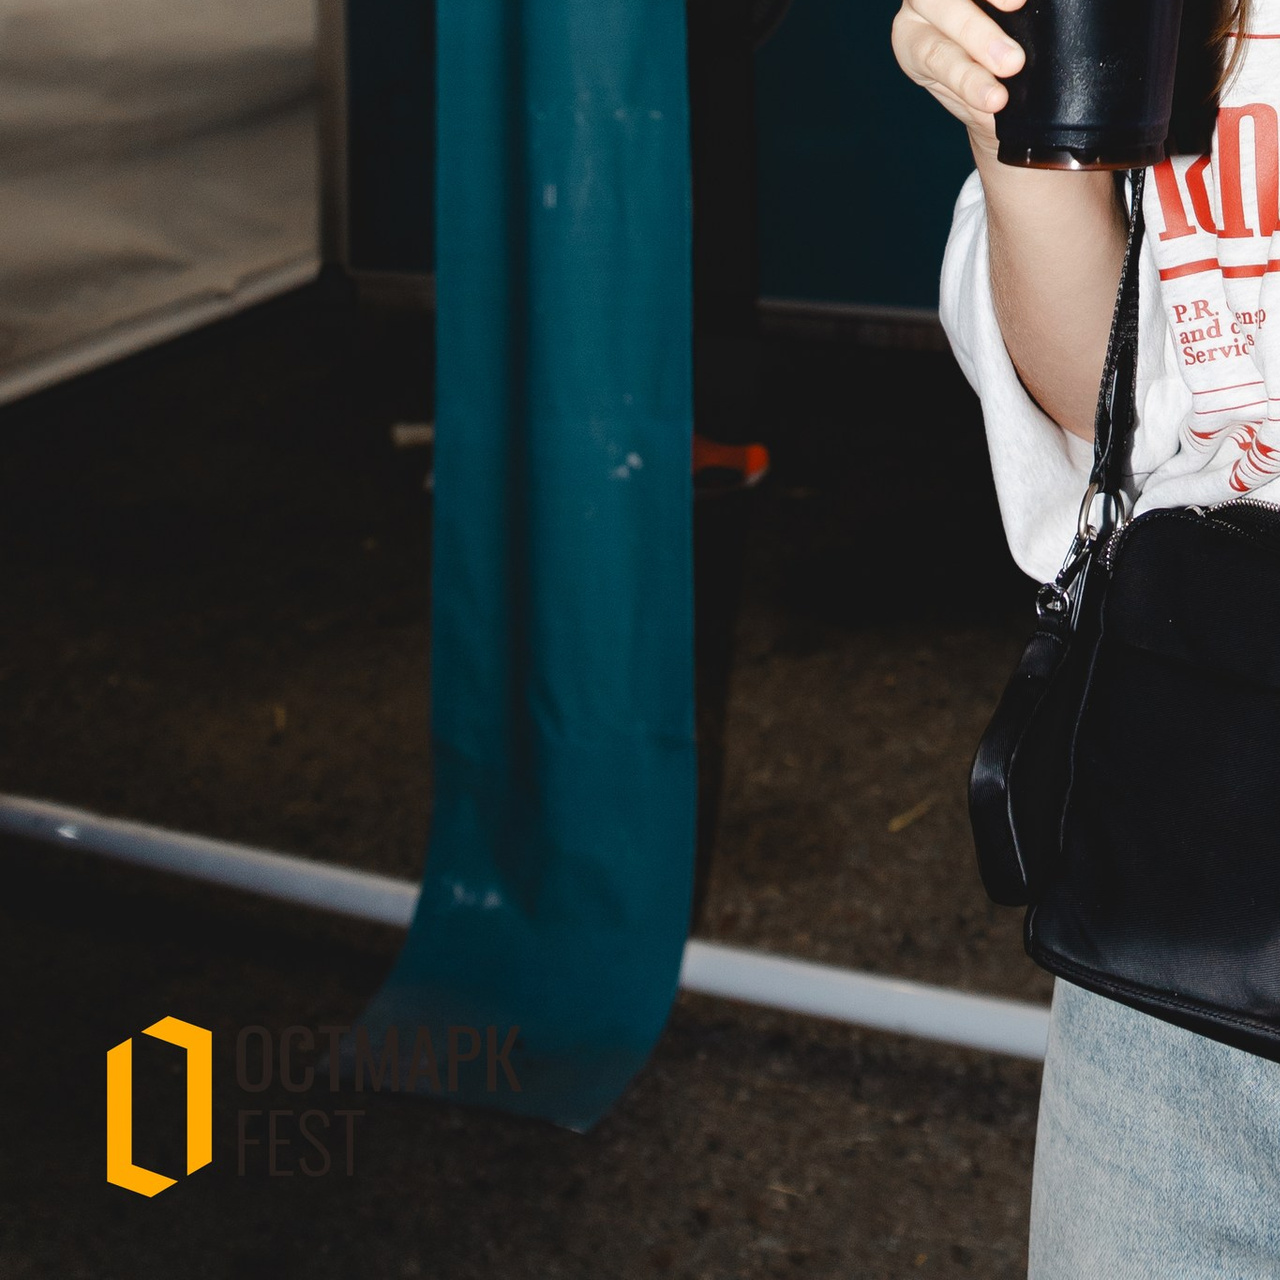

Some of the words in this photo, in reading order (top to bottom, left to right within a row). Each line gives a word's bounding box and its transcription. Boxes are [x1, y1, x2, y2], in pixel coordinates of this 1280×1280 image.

[1172, 299, 1220, 324] P.R.
[1179, 318, 1223, 345] and
[1183, 337, 1250, 366] Servic
